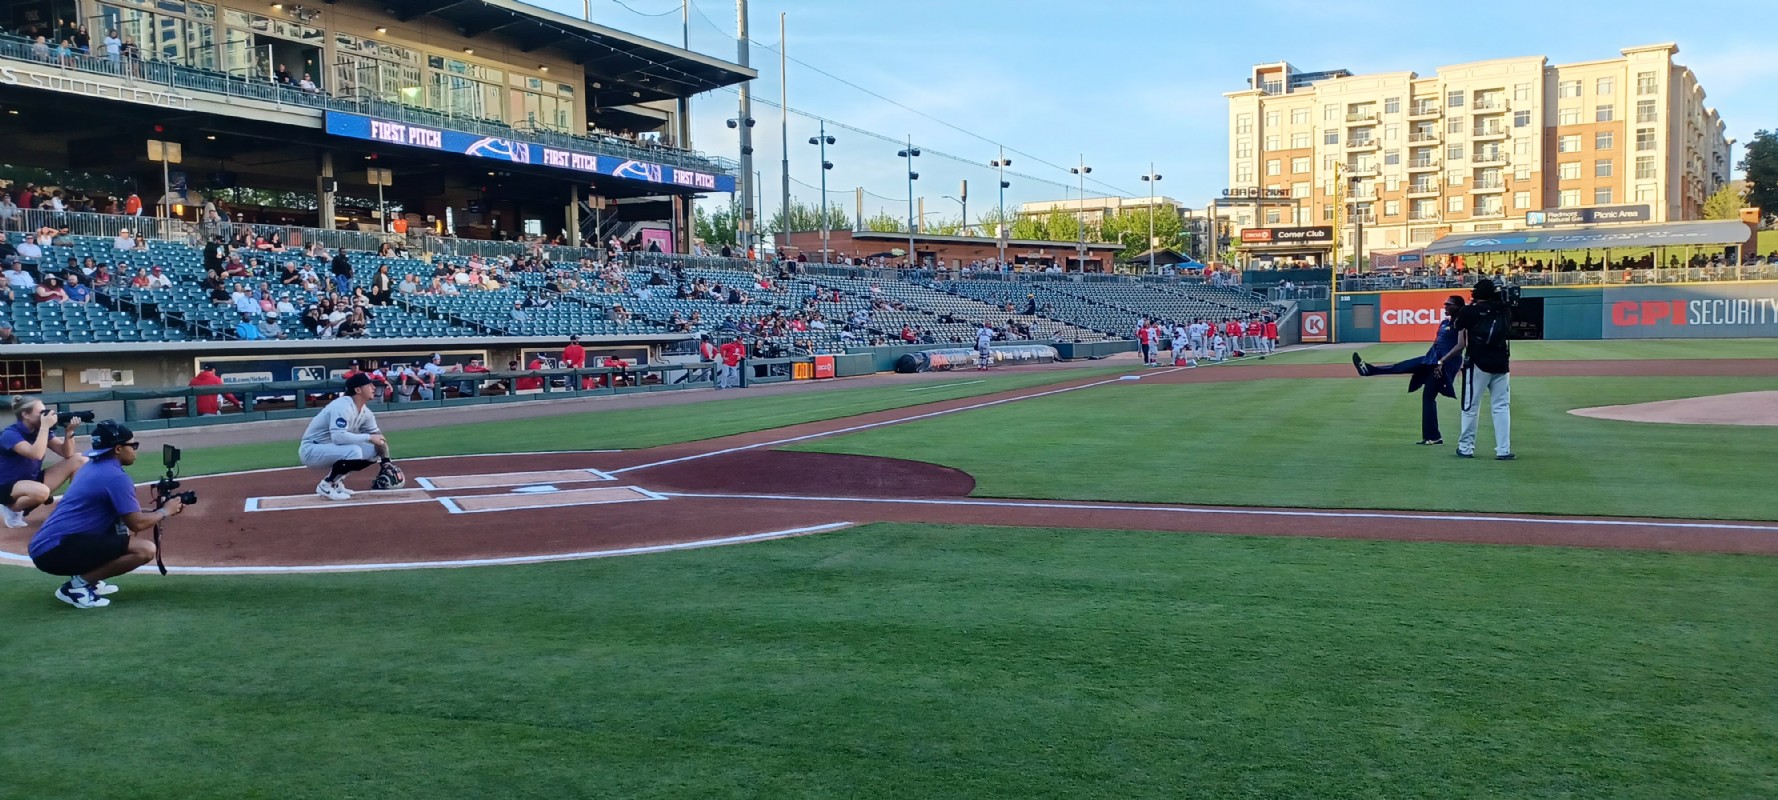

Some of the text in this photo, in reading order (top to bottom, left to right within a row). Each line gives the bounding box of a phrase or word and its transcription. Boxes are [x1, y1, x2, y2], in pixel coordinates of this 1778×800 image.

[371, 120, 442, 148] FIRST PITCH
[543, 148, 597, 171] FIRST PITCH
[673, 169, 715, 188] FIRST PITCH
[1594, 211, 1617, 219] Picnic
[1278, 231, 1305, 239] Corner
[1611, 298, 1778, 326] CPI SECURITY
